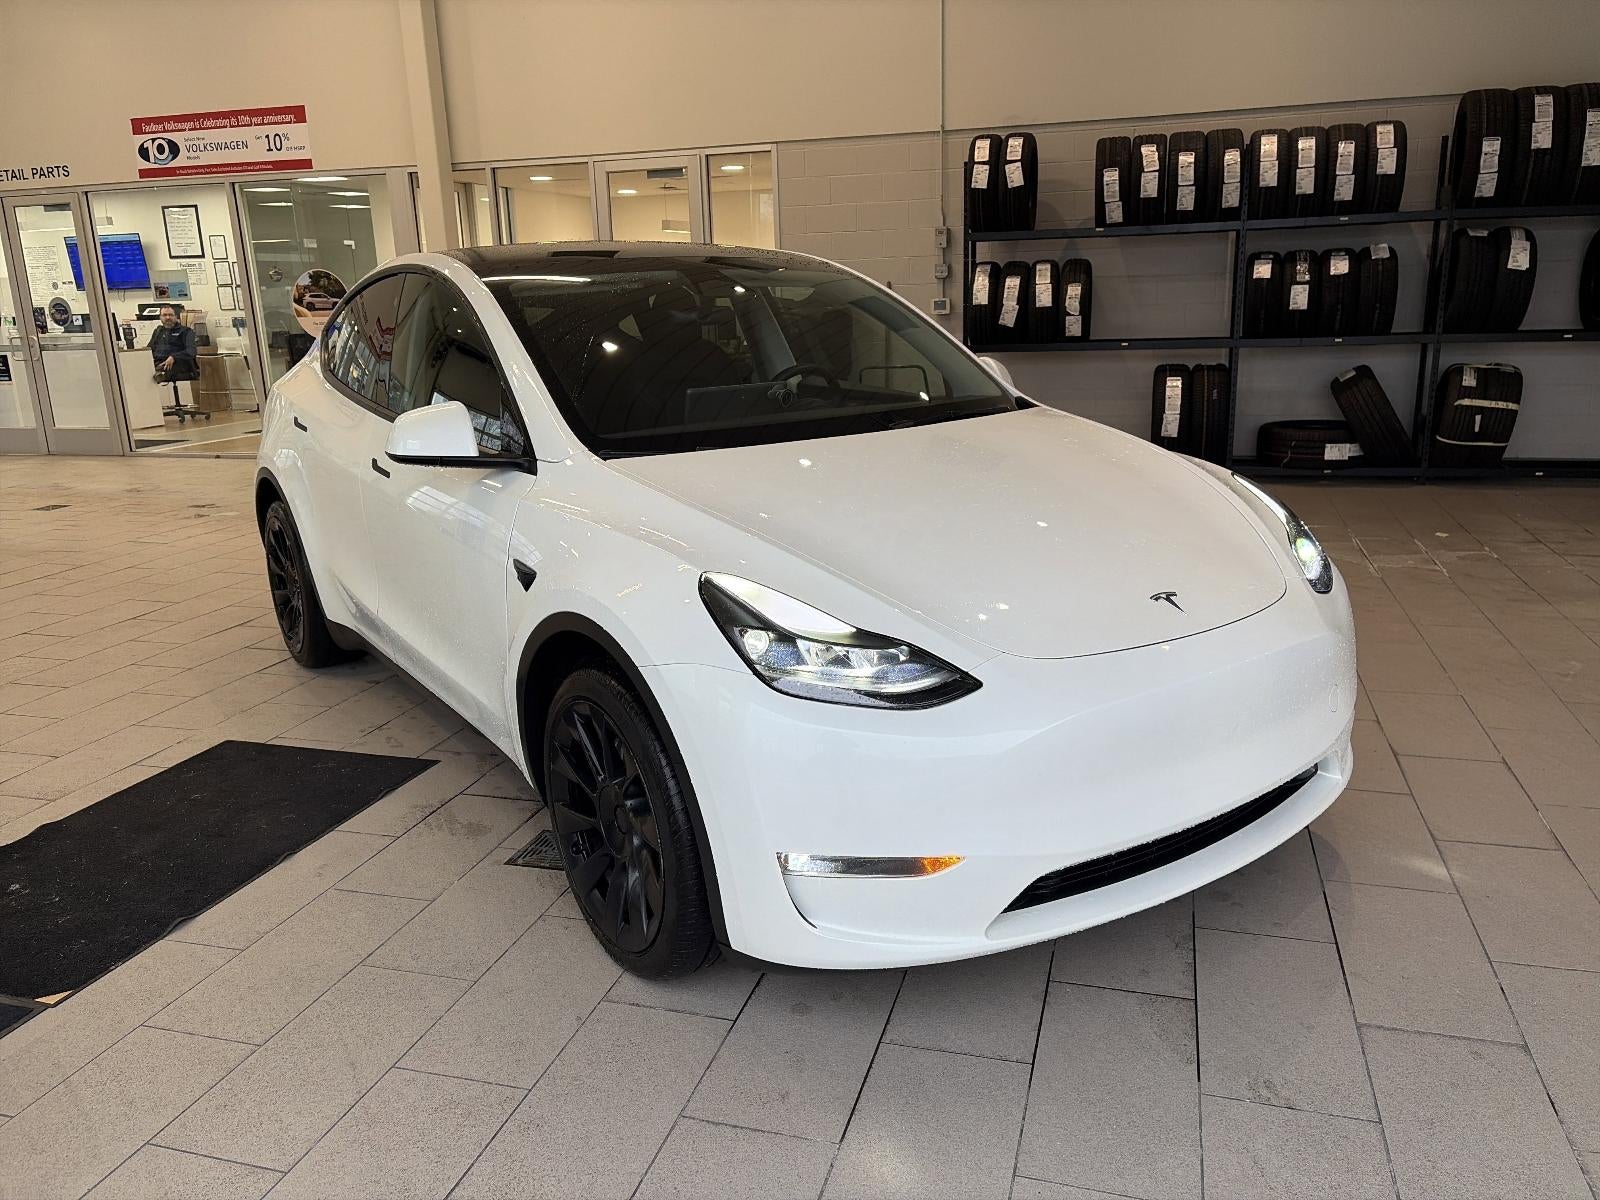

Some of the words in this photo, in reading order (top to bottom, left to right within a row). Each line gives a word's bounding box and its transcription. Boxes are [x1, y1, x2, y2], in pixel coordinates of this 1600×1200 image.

[163, 120, 195, 132] Volkswagen
[194, 119, 200, 129] is
[200, 116, 230, 129] Celebrating
[238, 115, 251, 125] 10th
[250, 116, 263, 127] year
[263, 113, 297, 124] anniversary.
[143, 138, 170, 164] 10
[185, 140, 249, 153] VOLKSWAGEN
[31, 165, 70, 179] PARTS
